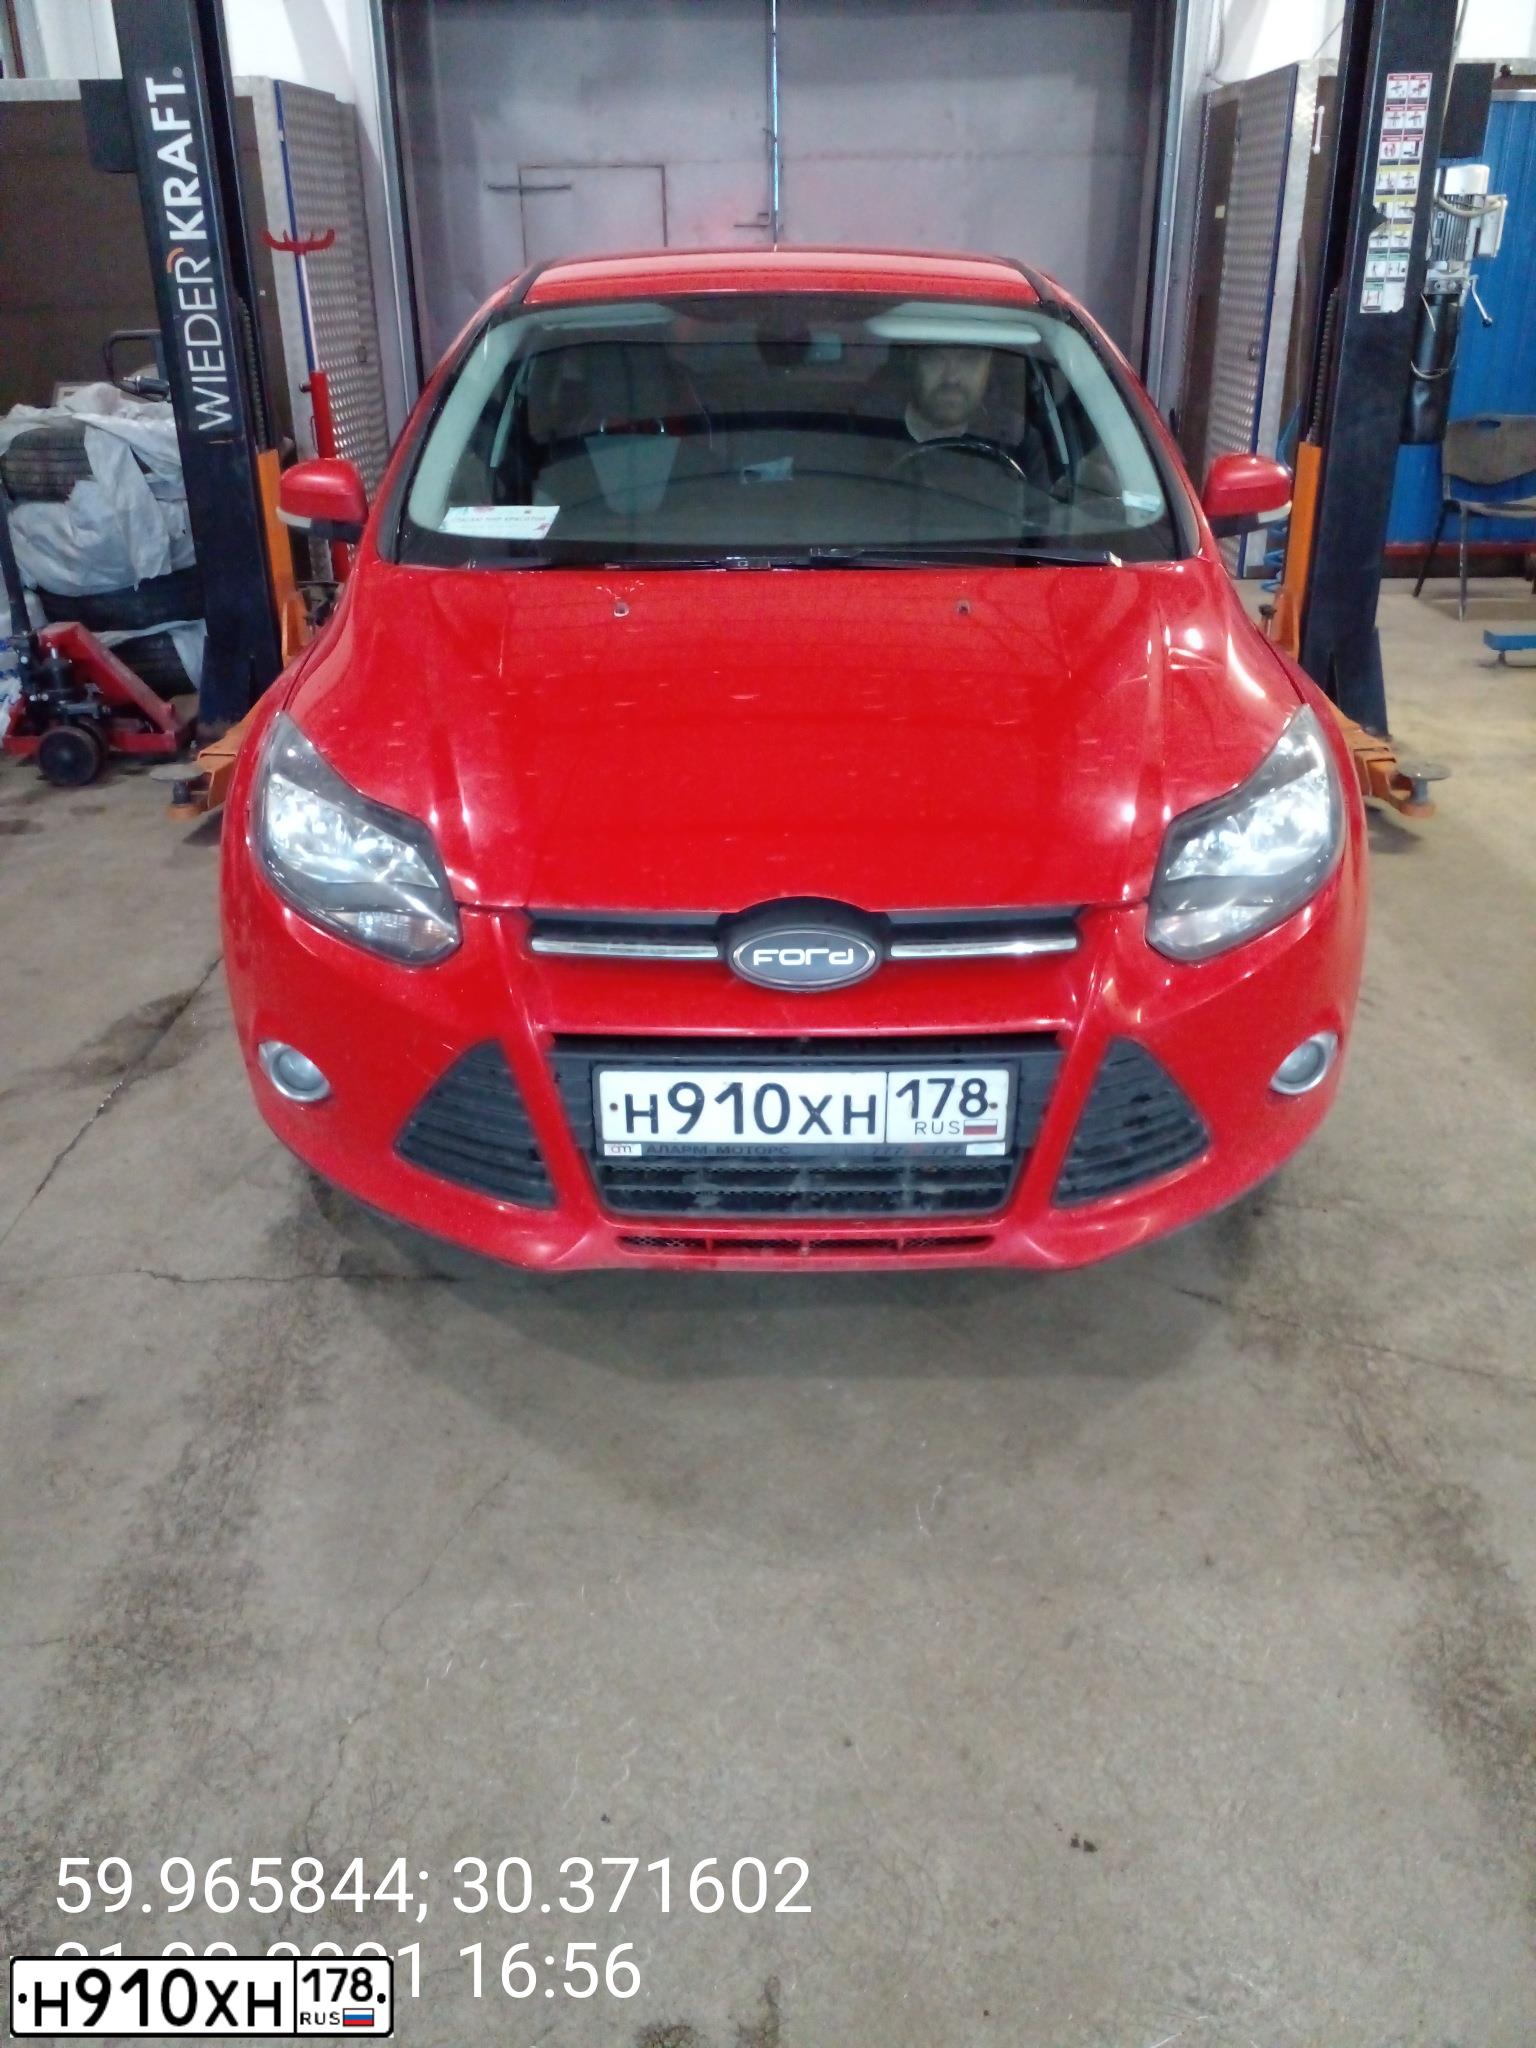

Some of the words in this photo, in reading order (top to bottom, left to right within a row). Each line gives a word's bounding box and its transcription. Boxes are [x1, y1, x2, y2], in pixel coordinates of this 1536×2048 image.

[753, 948, 854, 966] Ford
[896, 1077, 988, 1119] 178
[914, 1120, 961, 1136] RUS
